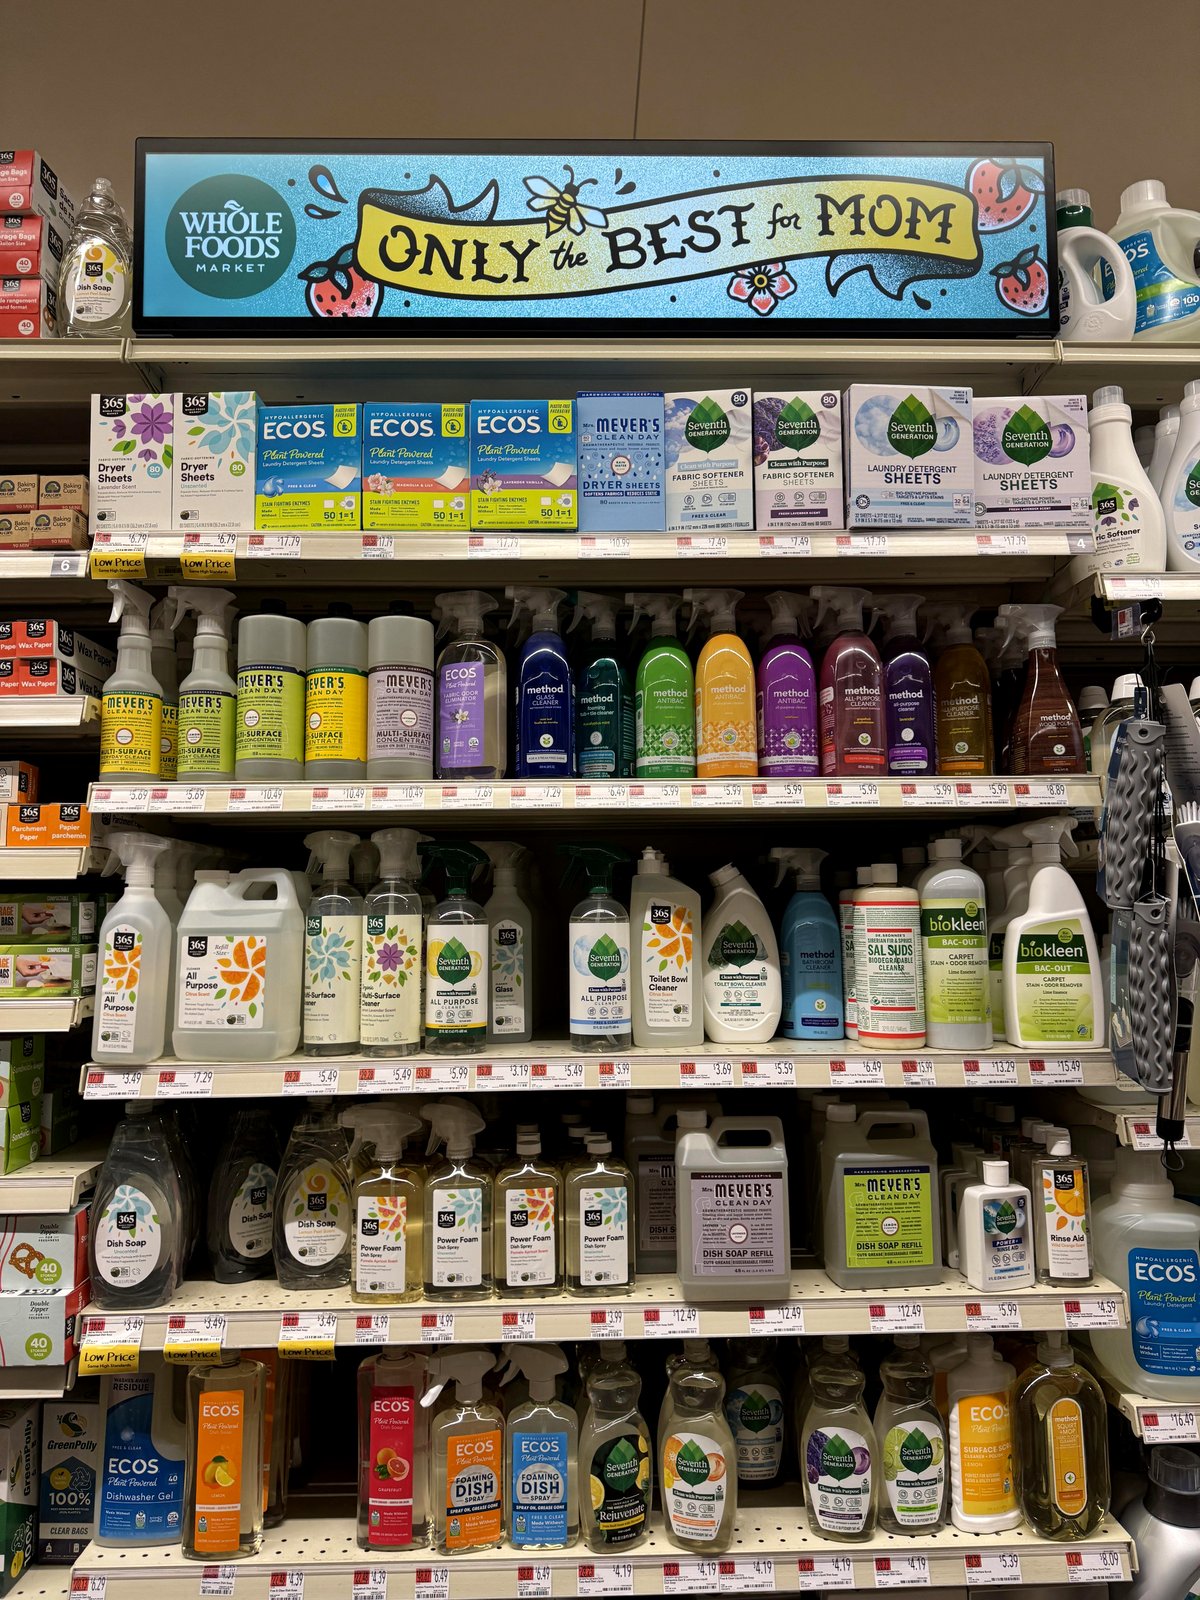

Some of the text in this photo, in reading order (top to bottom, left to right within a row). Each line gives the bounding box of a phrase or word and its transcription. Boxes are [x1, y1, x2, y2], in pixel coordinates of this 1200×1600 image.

[180, 206, 282, 234] WHOLE
[379, 193, 955, 283] ONLY the BEST for MOM
[185, 237, 280, 258] FOODS
[196, 264, 265, 272] MARKET
[102, 399, 123, 408] 365
[185, 397, 205, 407] 365
[370, 419, 433, 437] ECOS
[478, 416, 540, 434] ECOS
[597, 418, 660, 433] MEYER'S
[778, 420, 817, 429] Seventh
[264, 421, 325, 440] ECOS
[370, 448, 433, 459] Plant Powered
[478, 445, 540, 455] Plant Powered
[98, 464, 125, 473] Dryer
[181, 463, 208, 472] Dryer
[98, 474, 132, 482] Sheets
[181, 473, 214, 481] Sheets
[673, 471, 744, 481] FABRIC SOFTENER
[763, 472, 791, 480] FABRIC
[884, 474, 941, 484] SHEETS
[583, 481, 622, 489] DRYER
[1000, 479, 1058, 490] SHEETS
[218, 534, 236, 543] $6.79
[1107, 528, 1140, 539] Softener
[1077, 539, 1085, 548] 4
[61, 560, 70, 571] 6
[95, 558, 141, 567] Low Price
[184, 559, 231, 568] Low Price
[28, 622, 45, 632] 365
[34, 641, 52, 649] Paper
[37, 680, 56, 688] Paper
[386, 675, 432, 690] MEYER'S
[527, 684, 564, 695] method
[653, 689, 688, 698] method
[774, 689, 809, 698] method
[845, 686, 880, 695] method
[889, 690, 923, 699] method
[108, 697, 153, 709] MEYER'S
[377, 731, 431, 740] MULTI-SURFACE
[1047, 784, 1065, 795] $8.89
[368, 918, 383, 928] 365
[930, 915, 984, 931] biokleen
[868, 945, 913, 955] SAL SUDS
[1021, 941, 1083, 957] biokleen
[439, 957, 469, 966] Seventh
[186, 972, 197, 980] All
[186, 981, 218, 990] Purpose
[104, 1004, 134, 1012] Purpose
[565, 1064, 583, 1076] $5.49
[775, 1062, 793, 1074] $5.59
[992, 1061, 1015, 1072] $13.29
[1058, 1060, 1080, 1071] $15.49
[122, 1072, 141, 1084] $3.49
[194, 1072, 213, 1083] $7.29
[450, 1067, 468, 1079] $5.99
[1056, 1174, 1073, 1183] 365
[316, 1220, 336, 1228] Soap
[511, 1235, 531, 1243] Power
[1051, 1234, 1084, 1242] Rinse Aid
[125, 1240, 146, 1248] Soap
[856, 1242, 876, 1250] DISH
[878, 1242, 899, 1250] SOAP
[725, 1249, 748, 1257] SOAP
[40, 1263, 57, 1273] 40
[778, 1305, 801, 1320] $12.49
[898, 1304, 921, 1317] $12.49
[1098, 1301, 1116, 1314] $4.59
[30, 1337, 47, 1349] 40
[84, 1352, 135, 1362] Low Price
[113, 1383, 149, 1392] RESIDUE
[203, 1405, 240, 1417] ECOS
[374, 1400, 410, 1412] ECOS
[1170, 1411, 1194, 1427] $16.49
[47, 1440, 97, 1452] GreenPolly
[902, 1447, 931, 1455] Seventh
[822, 1453, 853, 1462] Seventh
[606, 1457, 638, 1472] Seventh
[607, 1467, 639, 1478] GENERATION
[455, 1473, 493, 1484] FOAMING
[456, 1481, 493, 1498] DISH
[522, 1481, 559, 1494] DISH
[49, 1492, 91, 1505] 100%
[106, 1491, 173, 1501] Dishwasher Gel
[600, 1504, 645, 1521] Rejuvenate
[832, 1558, 850, 1571] $4.19
[999, 1555, 1018, 1568] $5.39
[1100, 1552, 1118, 1566] $8.09
[536, 1567, 550, 1580] $6.49
[613, 1565, 632, 1578] $4.19
[371, 1571, 386, 1584] $4.39
